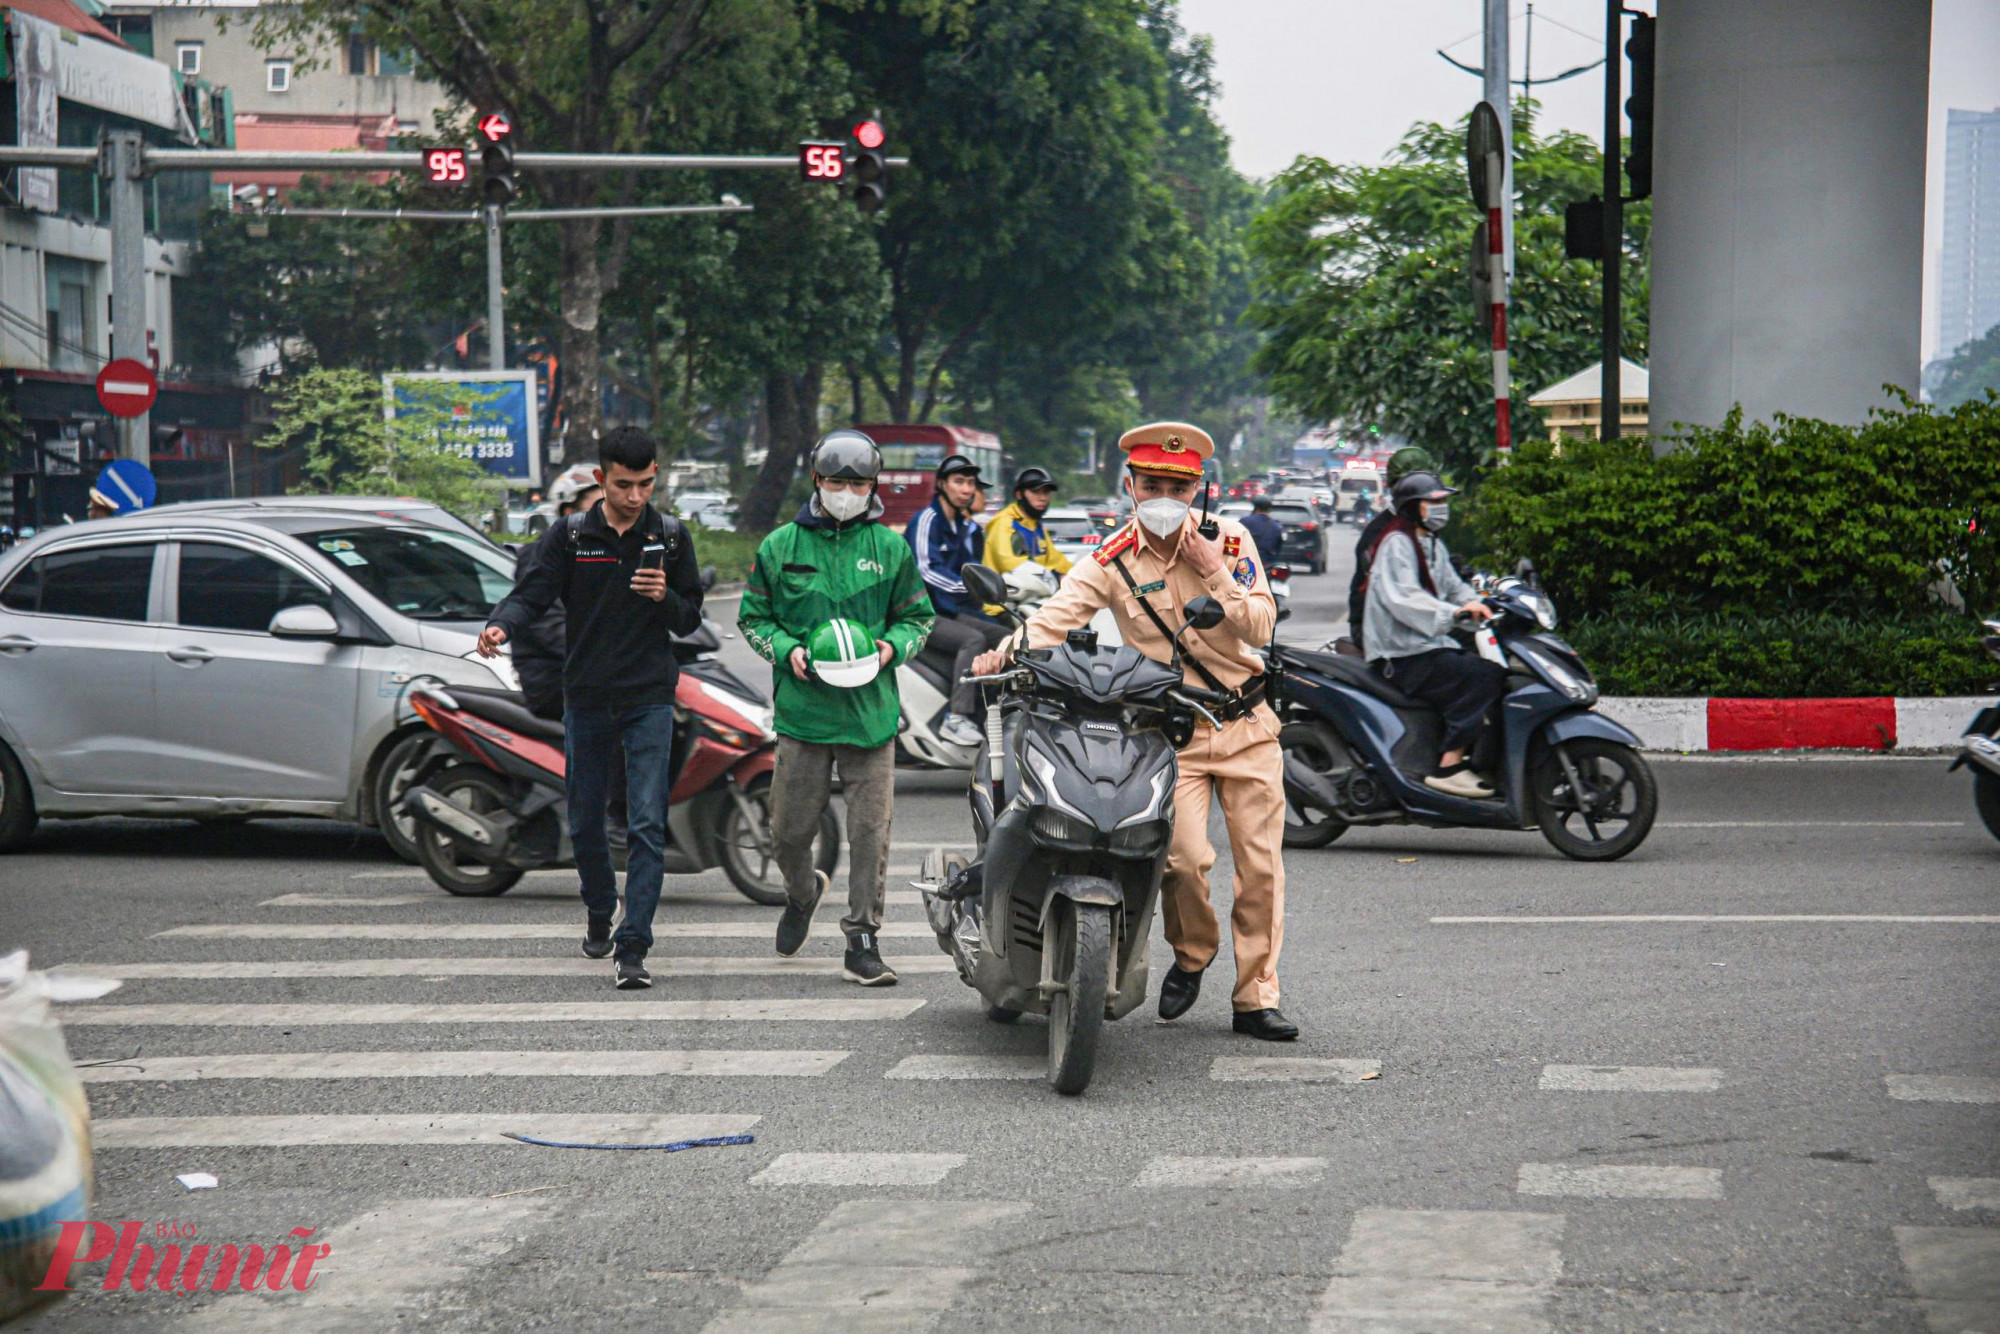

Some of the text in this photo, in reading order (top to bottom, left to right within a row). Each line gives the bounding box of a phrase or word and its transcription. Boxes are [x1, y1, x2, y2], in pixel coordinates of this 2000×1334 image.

[429, 151, 465, 181] 95
[806, 147, 842, 178] 56
[477, 442, 514, 458] 3333
[1086, 723, 1118, 731] HONDA
